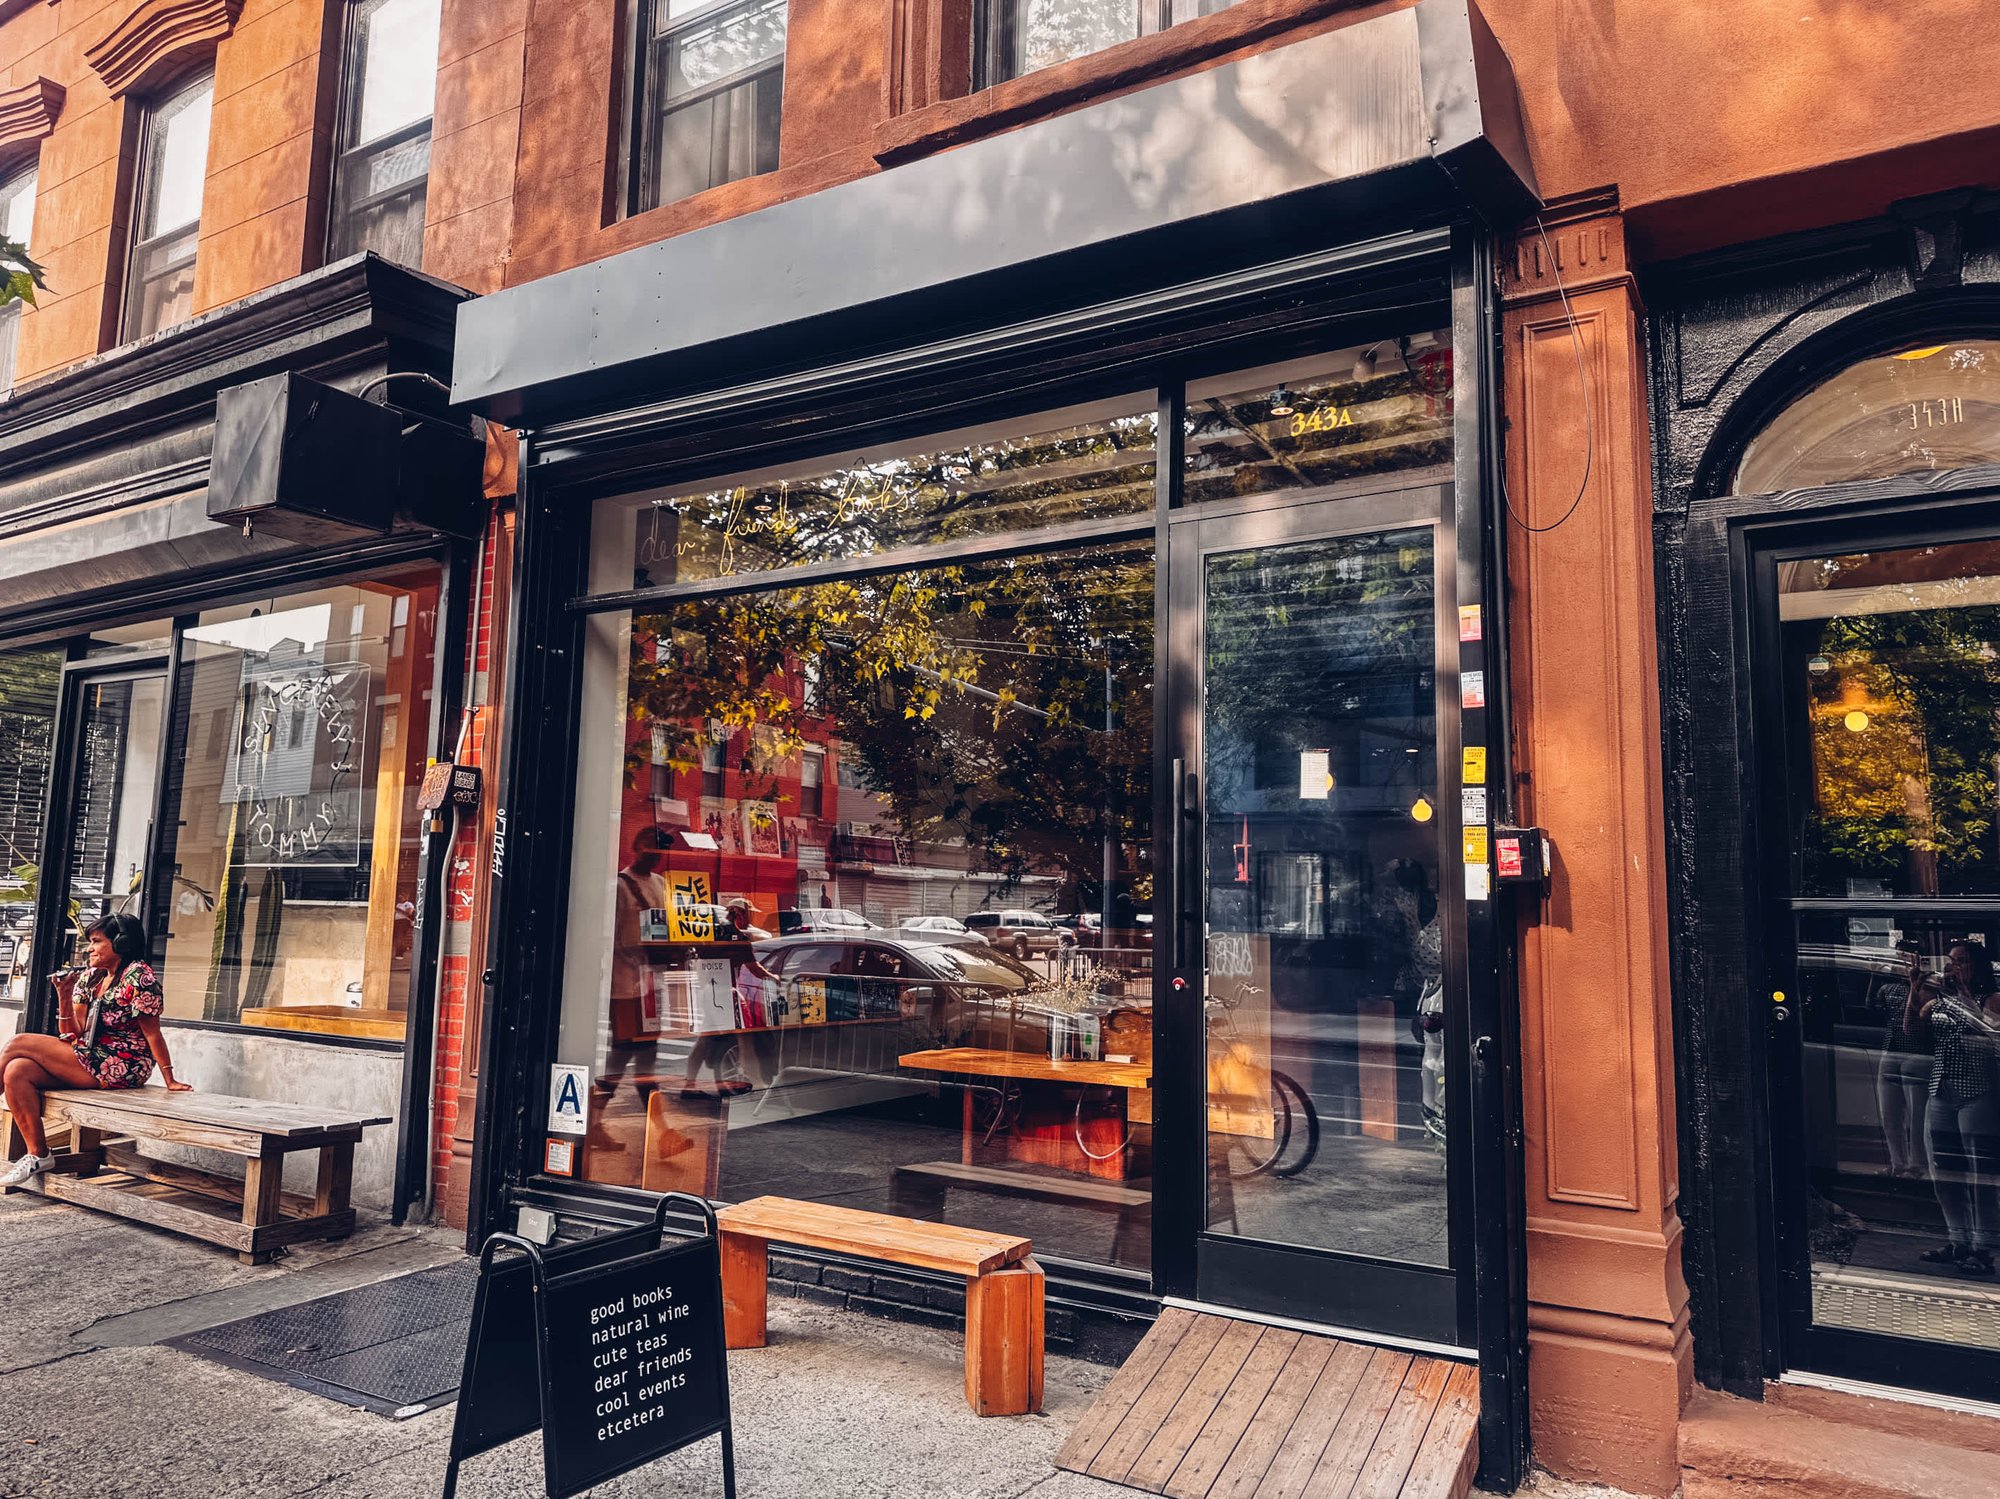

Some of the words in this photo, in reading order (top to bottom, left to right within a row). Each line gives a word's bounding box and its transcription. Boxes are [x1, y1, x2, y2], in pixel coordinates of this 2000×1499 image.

[1290, 406, 1354, 437] 343A
[556, 1073, 581, 1115] A
[590, 1298, 625, 1325] good
[633, 1286, 673, 1308] books
[592, 1314, 650, 1345] natural
[658, 1304, 689, 1324] wine
[593, 1347, 628, 1369] cute
[636, 1333, 668, 1354] teas
[594, 1370, 628, 1393] dear
[638, 1347, 692, 1377] friends
[596, 1392, 630, 1417] cool
[639, 1372, 686, 1400] events
[597, 1405, 665, 1441] etcetera
